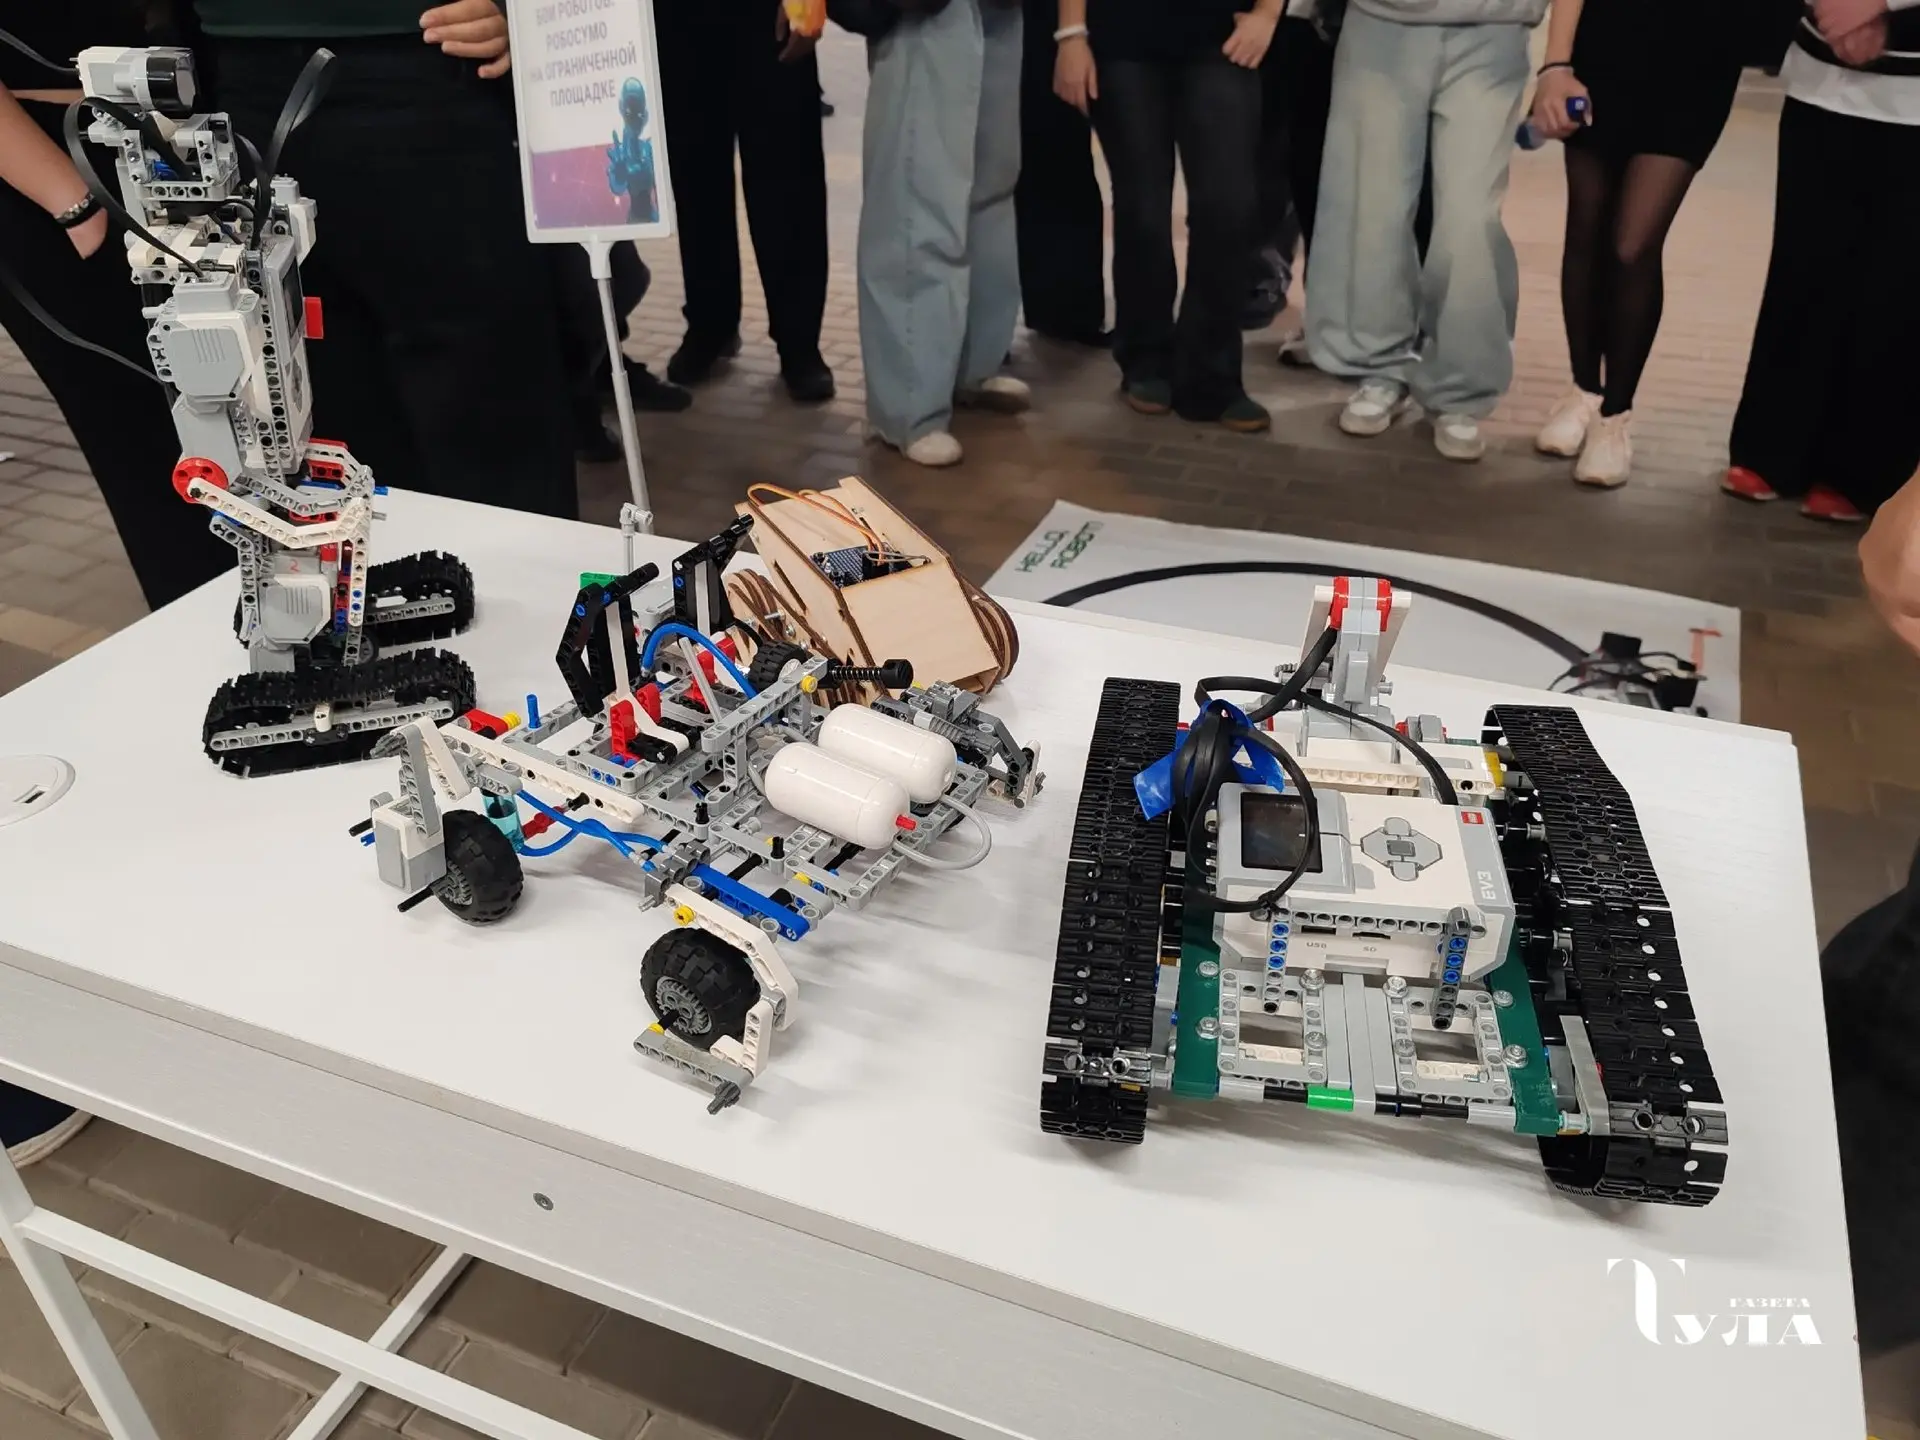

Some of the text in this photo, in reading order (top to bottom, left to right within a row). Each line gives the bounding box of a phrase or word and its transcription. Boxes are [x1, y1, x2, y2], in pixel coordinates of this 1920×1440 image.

[546, 21, 608, 51] РОБОСУМО
[545, 40, 636, 80] ОГРАНИЧЕННОЙ
[550, 79, 616, 107] ПЛОЩАДКЕ
[1477, 870, 1496, 900] EV3
[1306, 941, 1327, 949] USB
